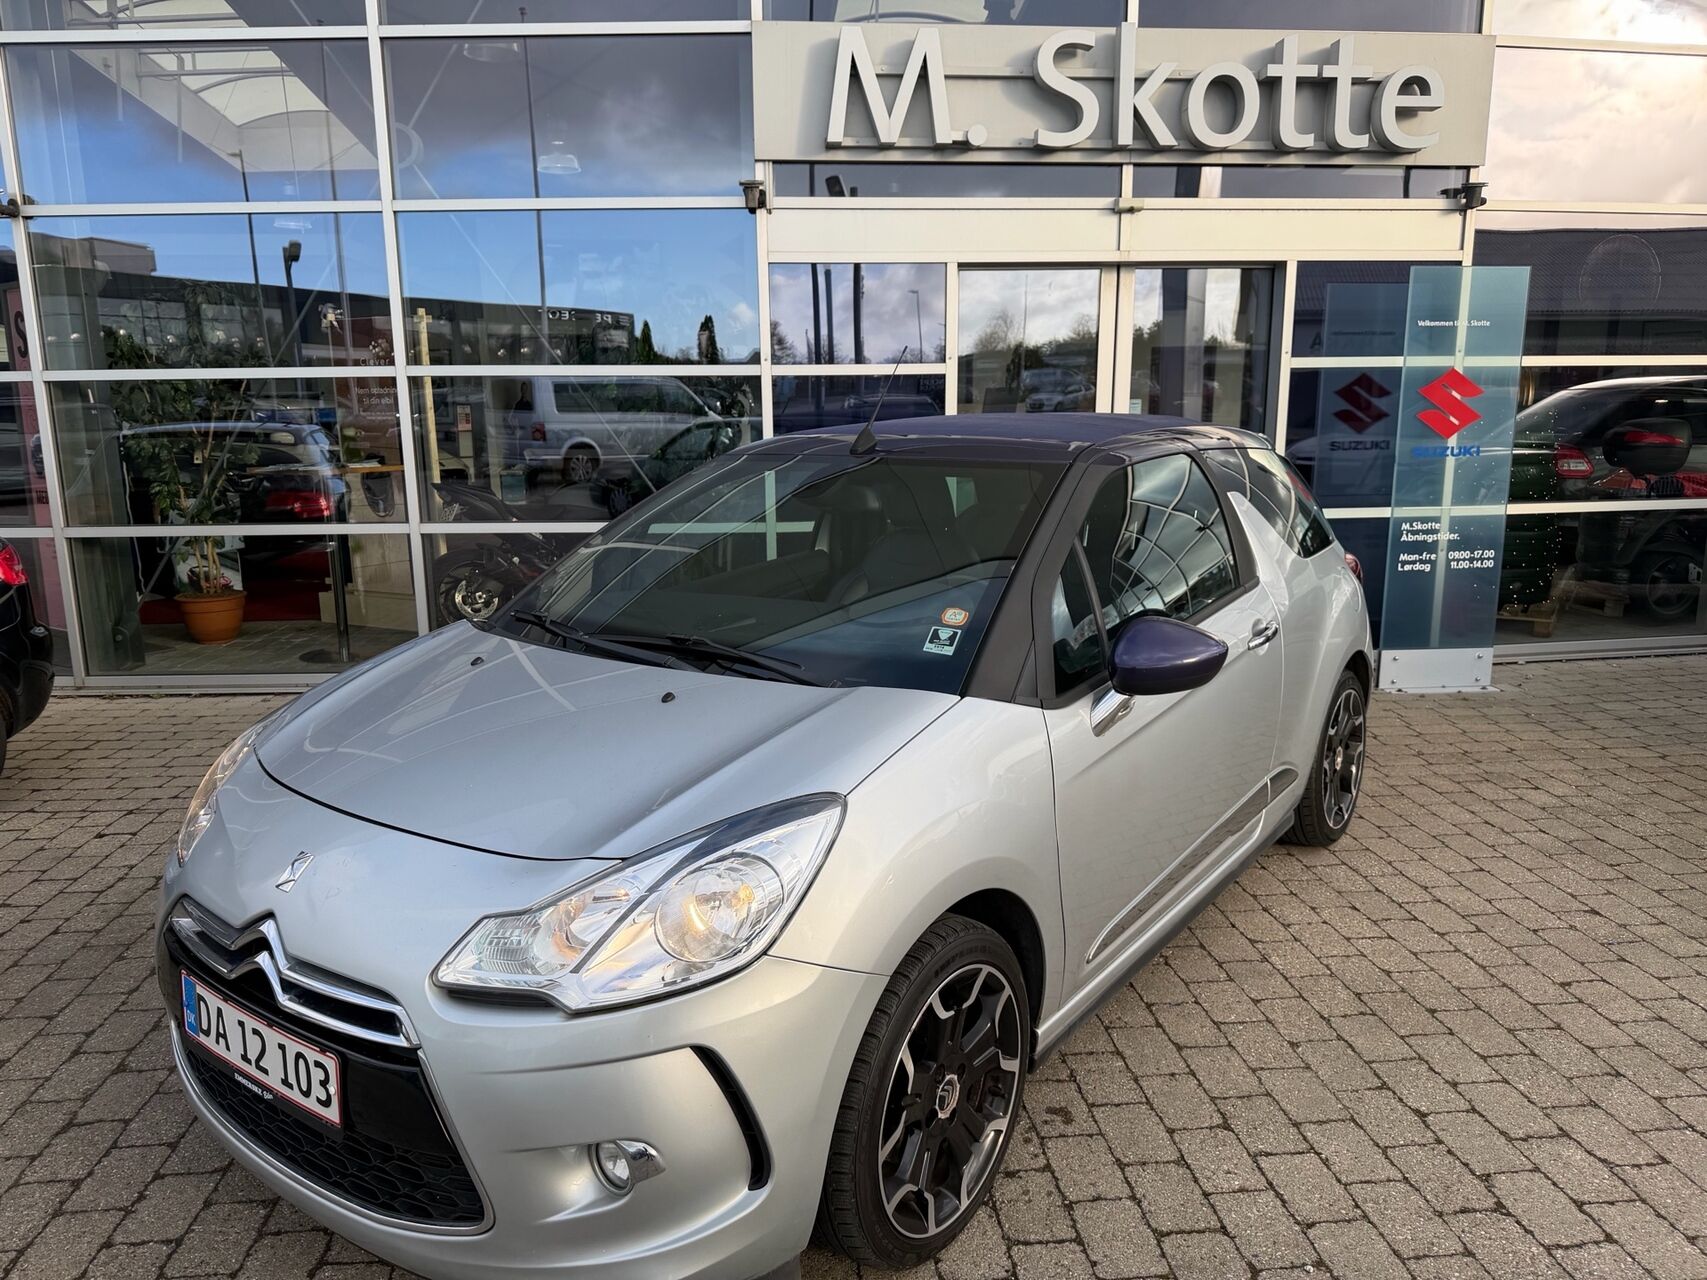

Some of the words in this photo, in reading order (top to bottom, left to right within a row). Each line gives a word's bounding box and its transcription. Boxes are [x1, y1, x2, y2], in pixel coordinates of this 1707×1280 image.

[826, 26, 988, 149] M.
[1033, 21, 1446, 152] Skotte
[1417, 319, 1454, 328] Velkommen
[1470, 319, 1491, 327] Skotte
[1329, 440, 1390, 451] SUZUKI
[1412, 445, 1481, 458] SUZUKI
[1401, 521, 1441, 531] M.Skotte
[1400, 530, 1461, 543] Åbningstider.
[1398, 552, 1438, 561] Man-fre
[1397, 563, 1431, 572] Lørdag
[1449, 559, 1495, 569] 11.00-14.00
[186, 1009, 196, 1026] DK
[197, 992, 231, 1052] DA
[237, 1019, 270, 1077] 12
[277, 1042, 333, 1109] 103
